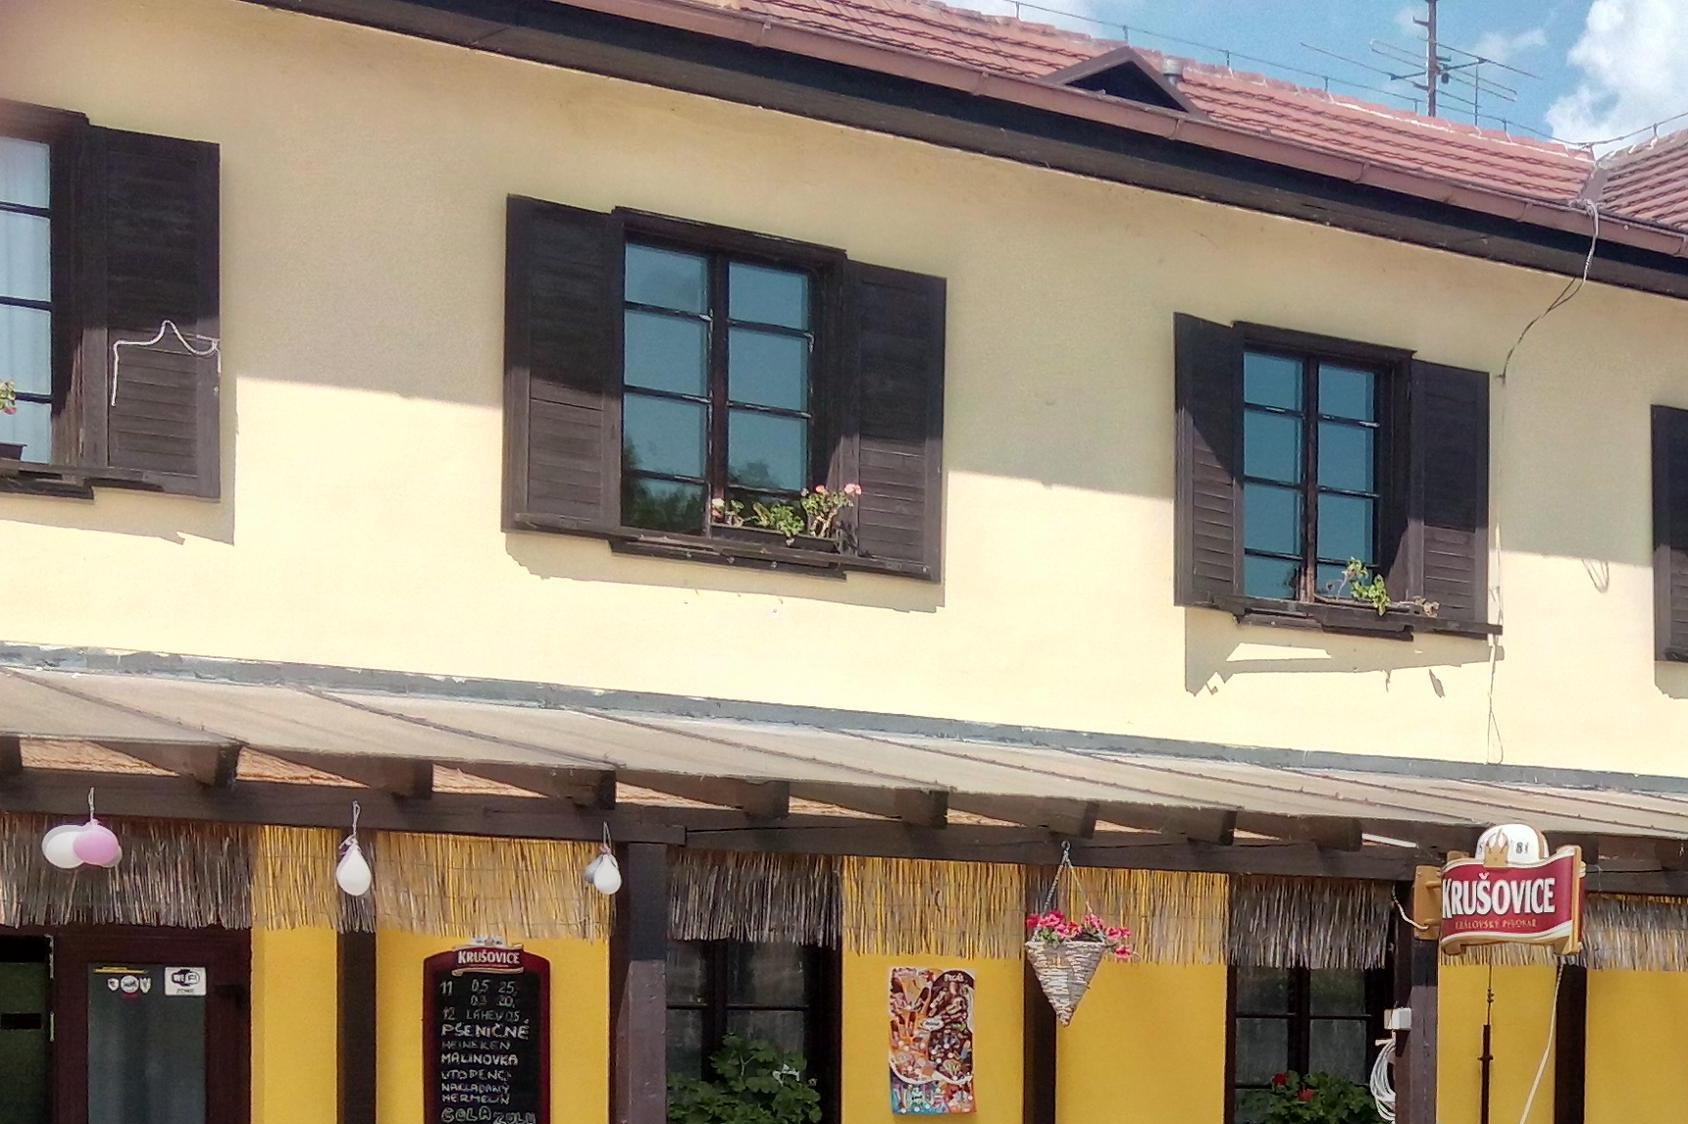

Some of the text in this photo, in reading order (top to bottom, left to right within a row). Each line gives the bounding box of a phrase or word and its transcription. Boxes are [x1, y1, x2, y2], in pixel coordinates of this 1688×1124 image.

[1442, 872, 1555, 918] KRUŠOVICE
[457, 949, 520, 964] KRUŠOVICE
[441, 1018, 530, 1040] PŠENIČNÉ
[441, 1051, 519, 1066] MALINOVKA
